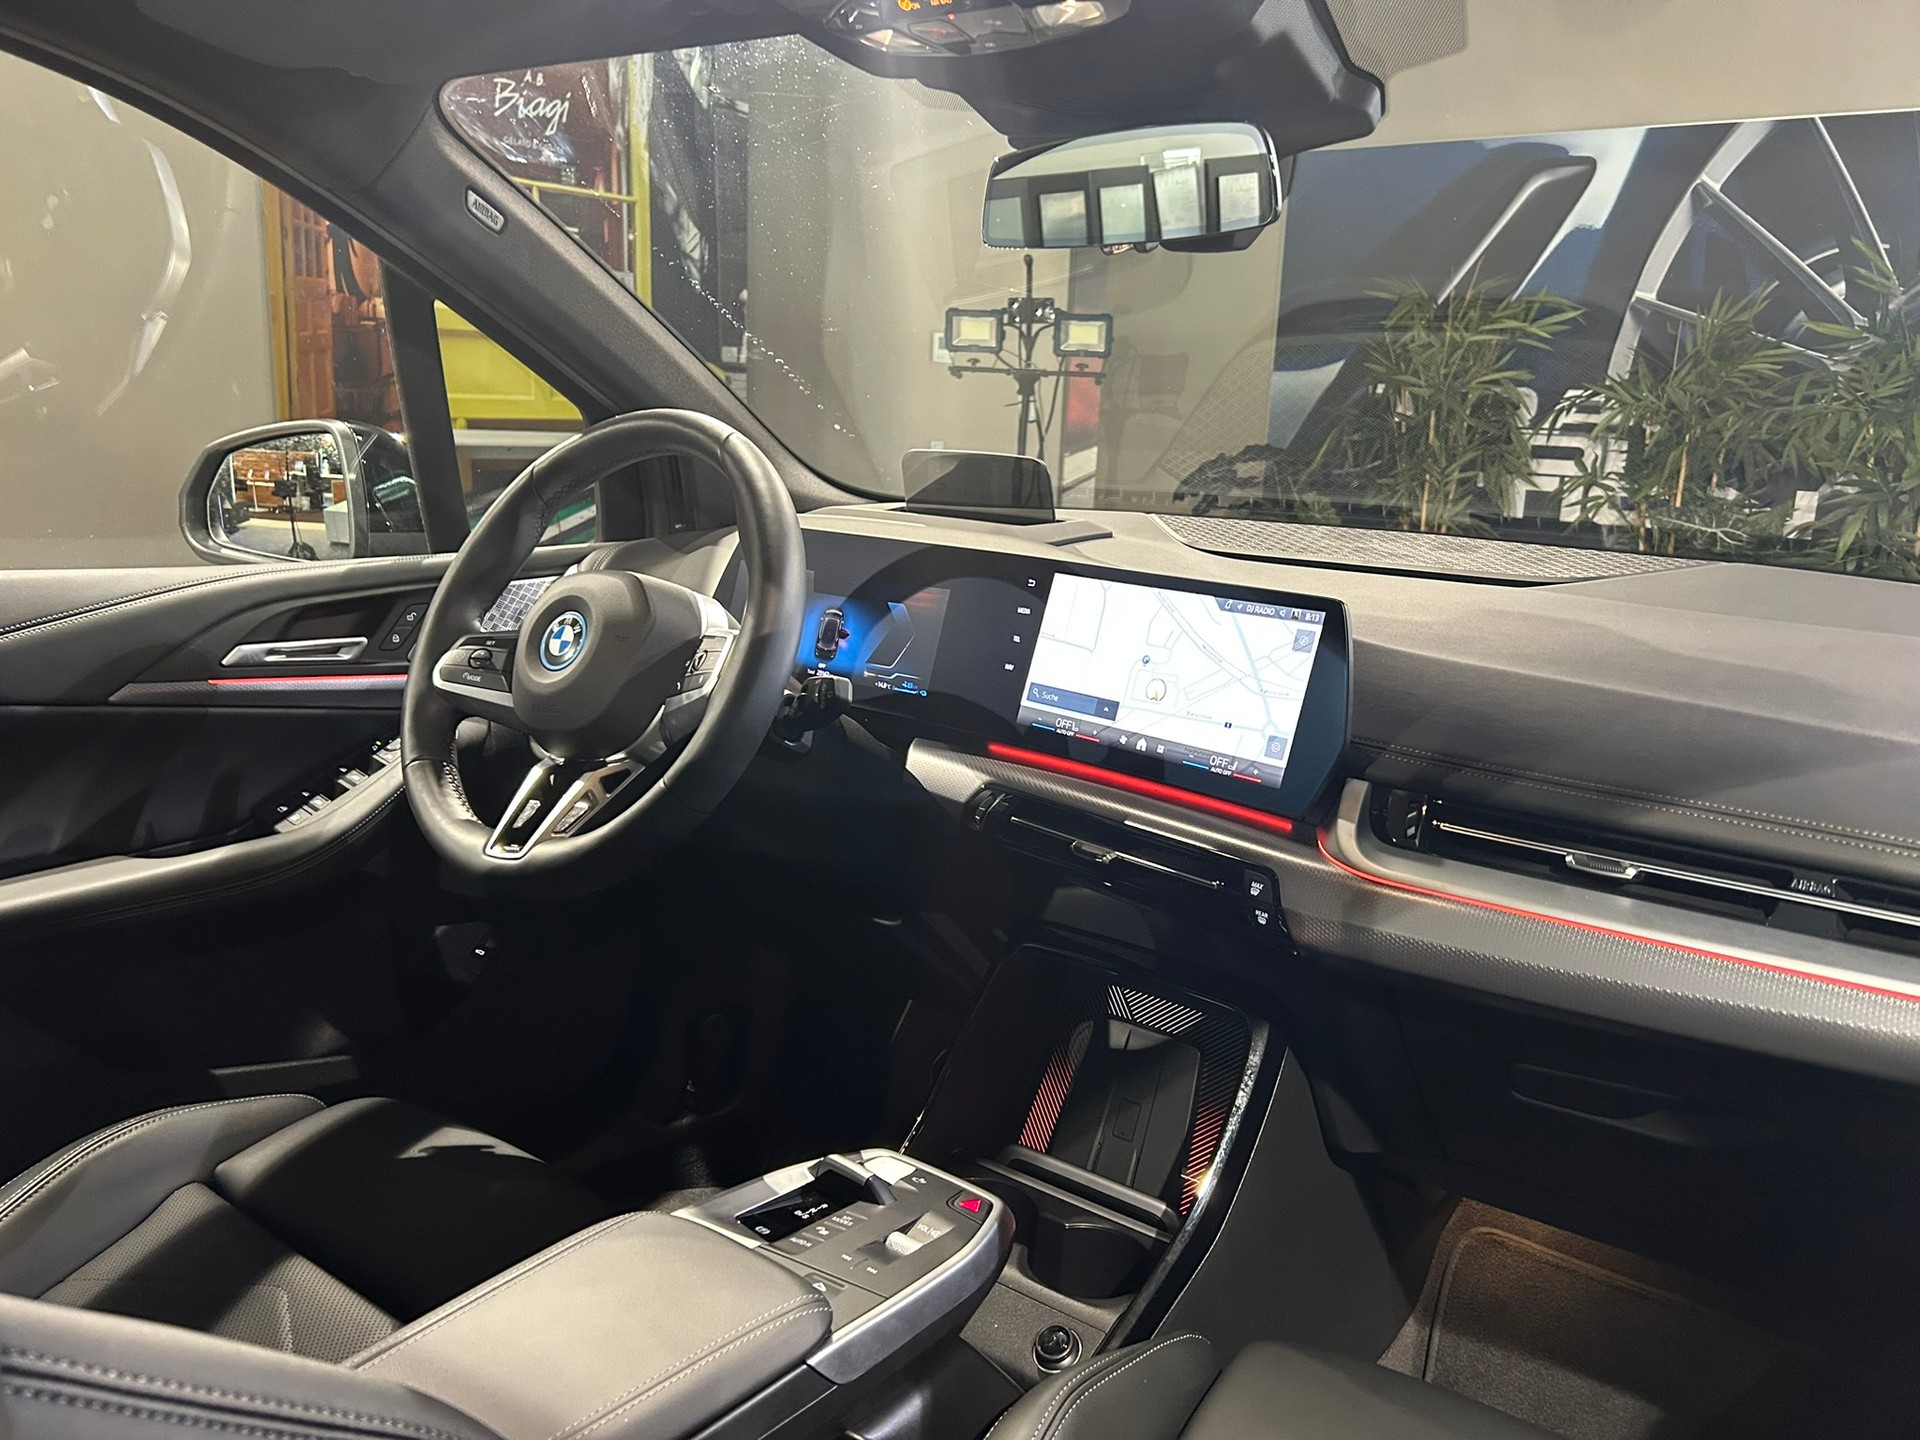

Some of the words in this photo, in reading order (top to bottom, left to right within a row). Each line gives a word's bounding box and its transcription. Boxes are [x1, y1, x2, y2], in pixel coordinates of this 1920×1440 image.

[494, 77, 571, 136] Biagi
[1254, 605, 1275, 616] RADIO
[1305, 613, 1320, 622] 8:13
[1041, 691, 1059, 702] Suche
[1055, 717, 1073, 729] OFF
[1056, 728, 1067, 736] AUTO
[1209, 755, 1230, 768] OFF
[1210, 767, 1222, 775] AUTO
[1251, 881, 1264, 890] MAX
[1791, 878, 1831, 894] AIRBAG
[1255, 909, 1269, 919] REAR
